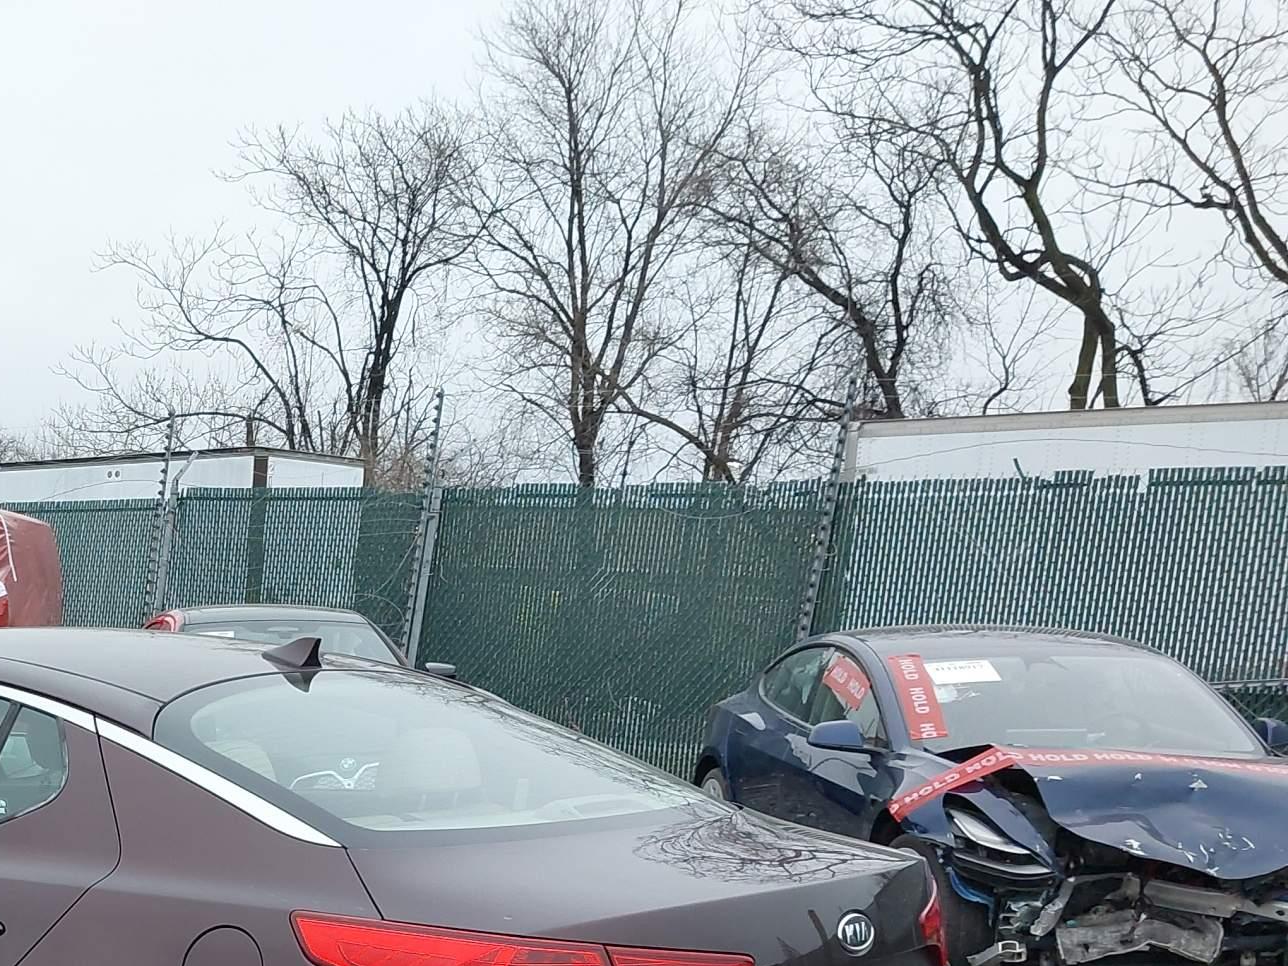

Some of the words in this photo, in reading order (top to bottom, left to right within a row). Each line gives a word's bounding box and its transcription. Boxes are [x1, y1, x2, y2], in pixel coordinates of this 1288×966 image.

[899, 659, 919, 680] HOLD
[910, 687, 930, 714] HOLD
[904, 772, 961, 803] HOLD
[1029, 752, 1088, 763] HOLD
[1094, 751, 1153, 762] HOLD
